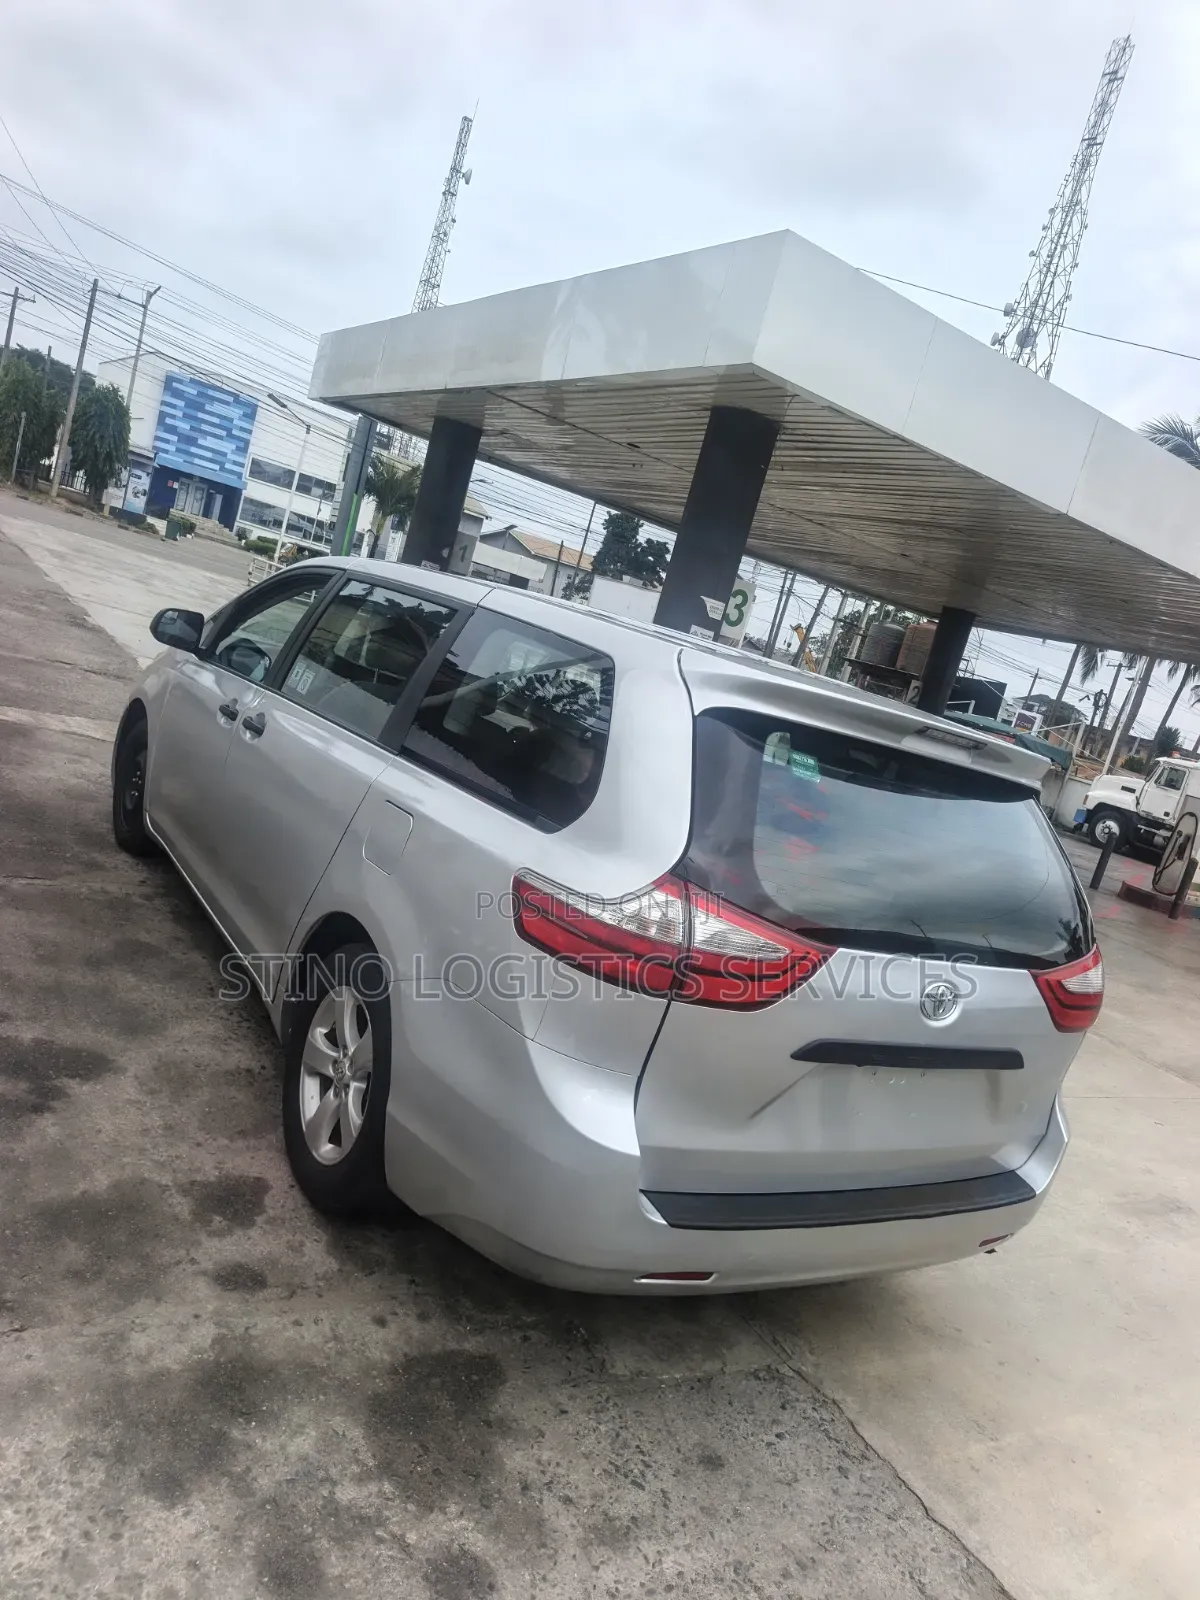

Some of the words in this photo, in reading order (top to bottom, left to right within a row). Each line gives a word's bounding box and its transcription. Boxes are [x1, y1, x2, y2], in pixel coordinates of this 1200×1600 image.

[458, 544, 468, 563] 1
[724, 588, 748, 628] 3
[907, 685, 921, 706] 2
